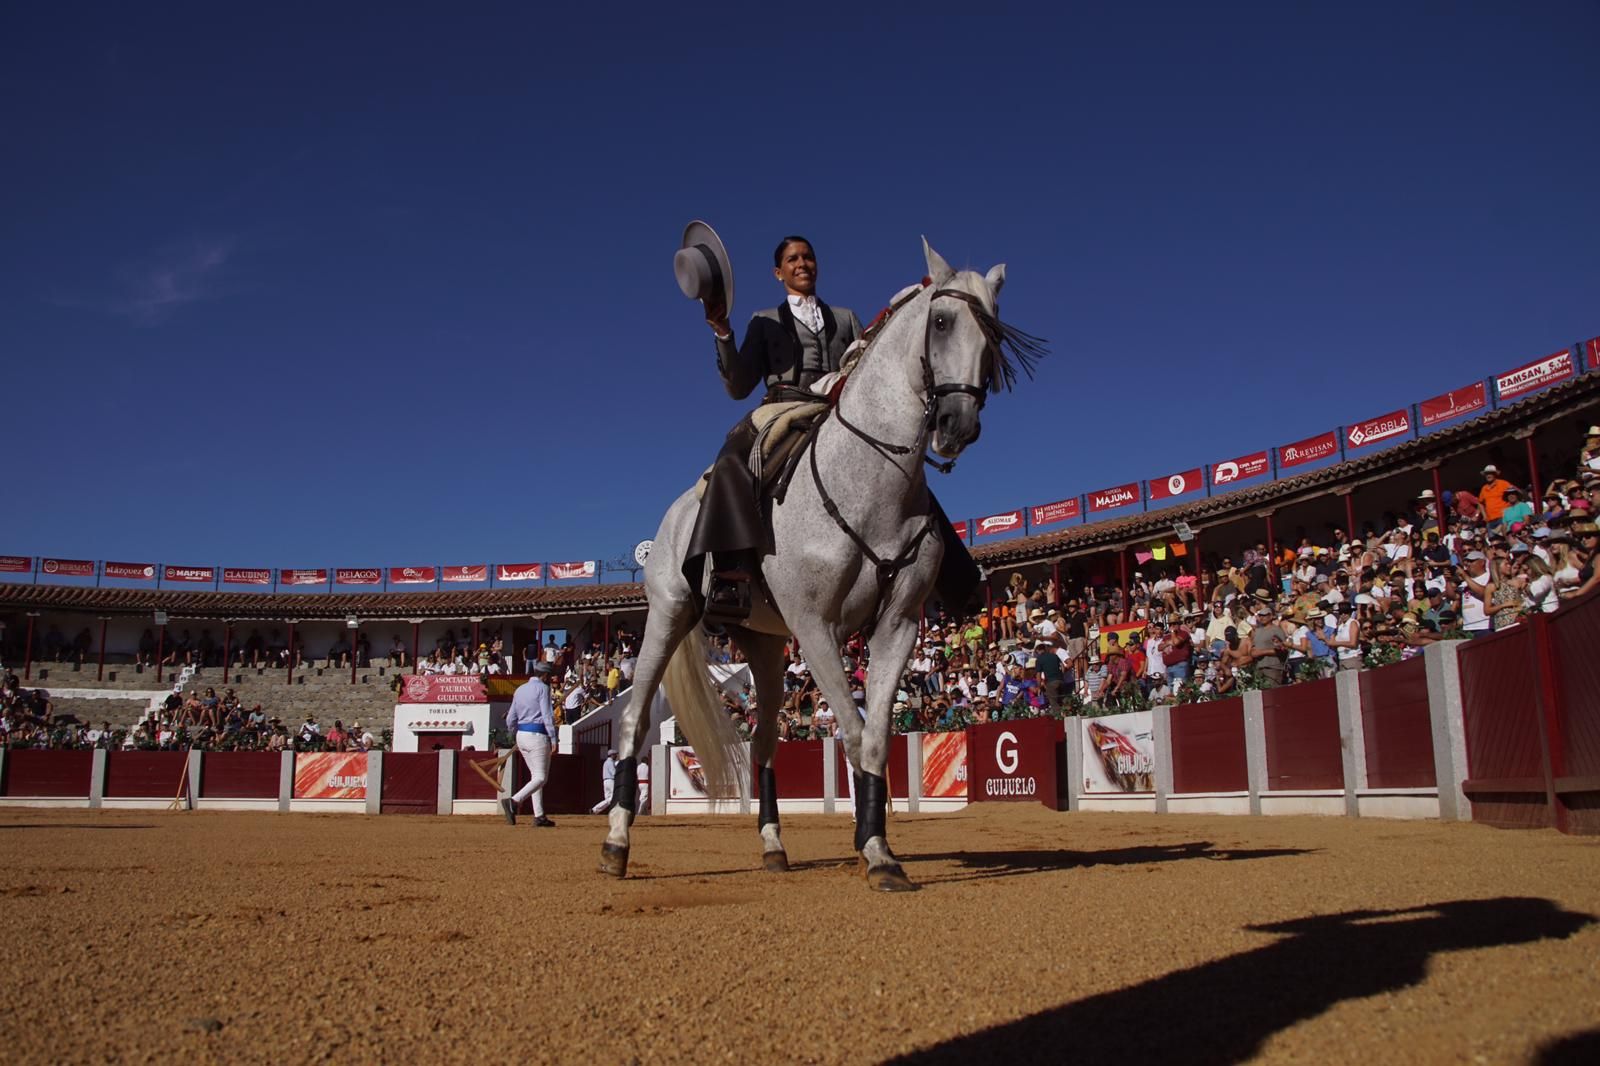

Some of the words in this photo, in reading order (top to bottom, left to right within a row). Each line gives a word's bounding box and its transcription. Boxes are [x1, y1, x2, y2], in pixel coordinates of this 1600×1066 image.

[1500, 366, 1546, 388] RAMSAN,
[1364, 416, 1408, 437] GARBLA
[1299, 441, 1333, 457] REVISAN
[1095, 490, 1133, 508] MAJUMA
[176, 569, 213, 578] MAPFRE
[510, 571, 536, 579] CAYO
[437, 694, 475, 702] GUIJUELO
[995, 731, 1019, 775] G
[986, 776, 1036, 796] GUIJUELO
